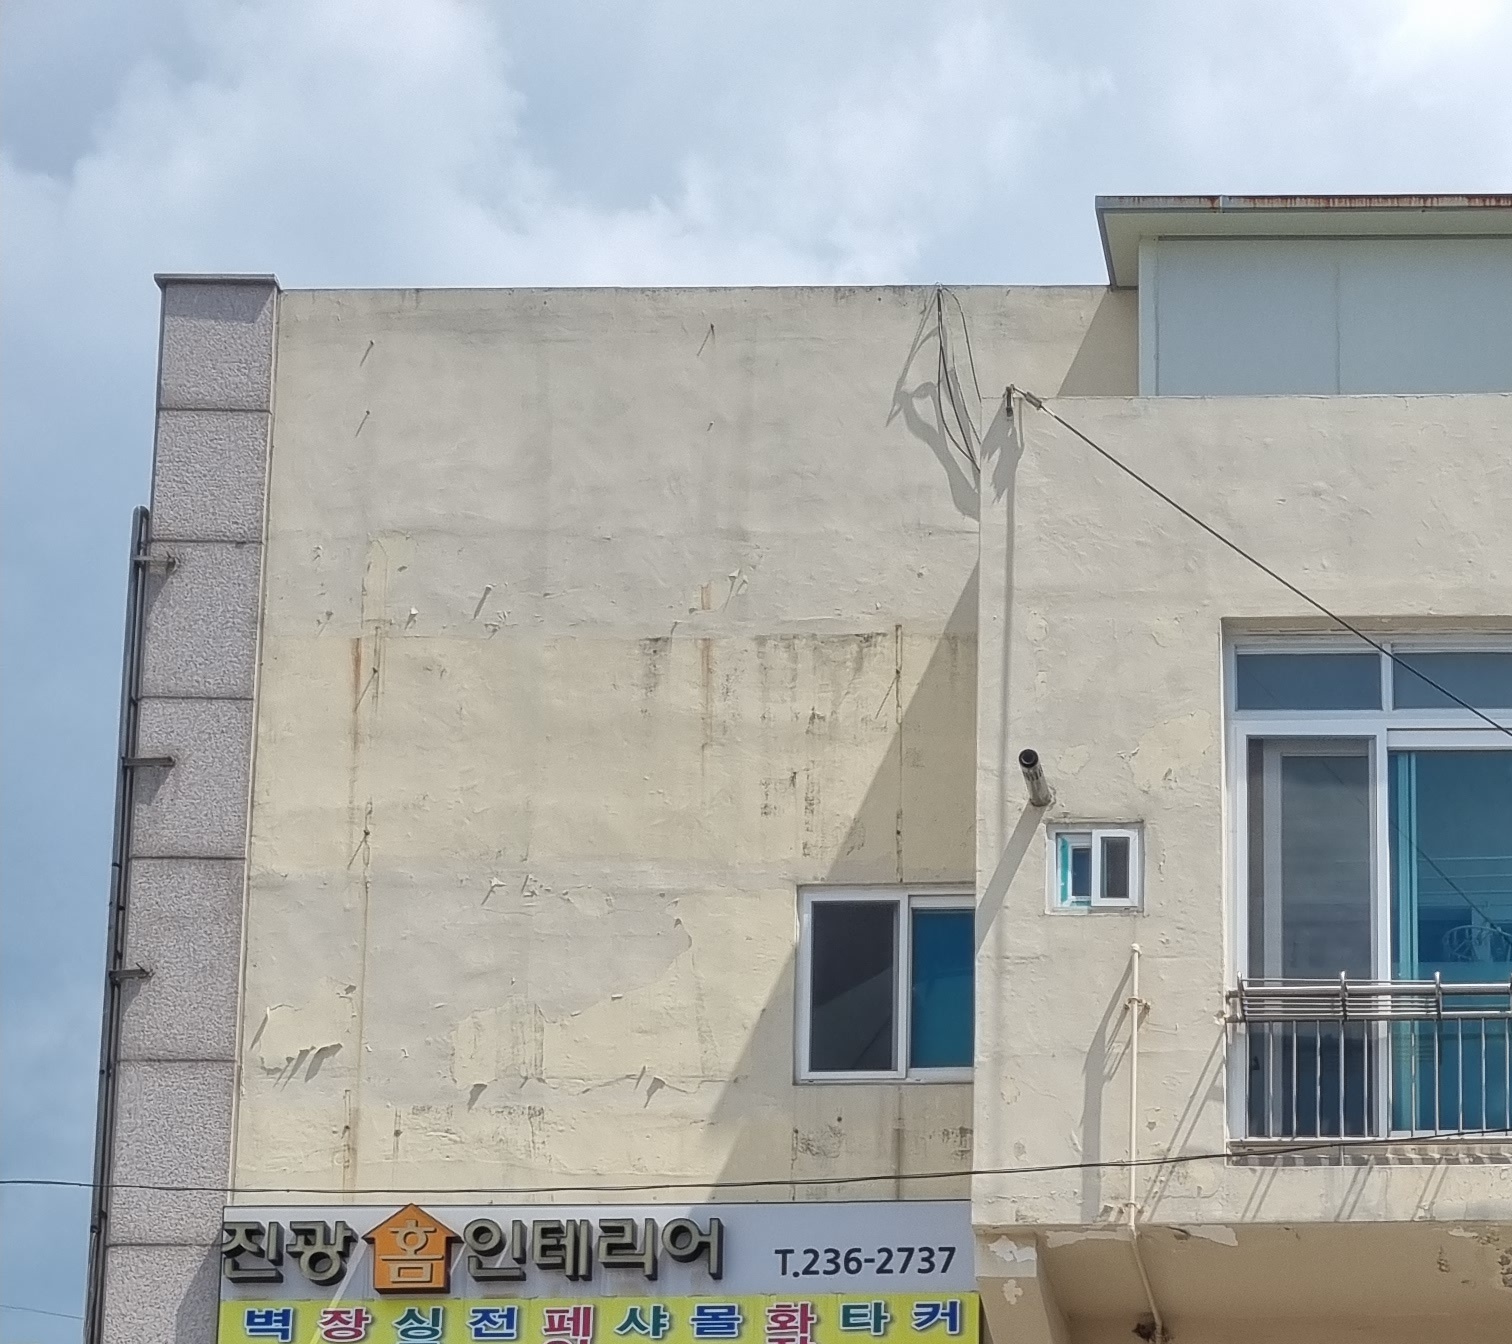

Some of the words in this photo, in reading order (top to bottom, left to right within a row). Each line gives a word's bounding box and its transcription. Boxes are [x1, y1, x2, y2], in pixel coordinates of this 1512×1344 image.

[223, 1220, 357, 1286] 진광
[463, 1217, 724, 1281] 인테리어
[775, 1246, 957, 1279] T.236-2737
